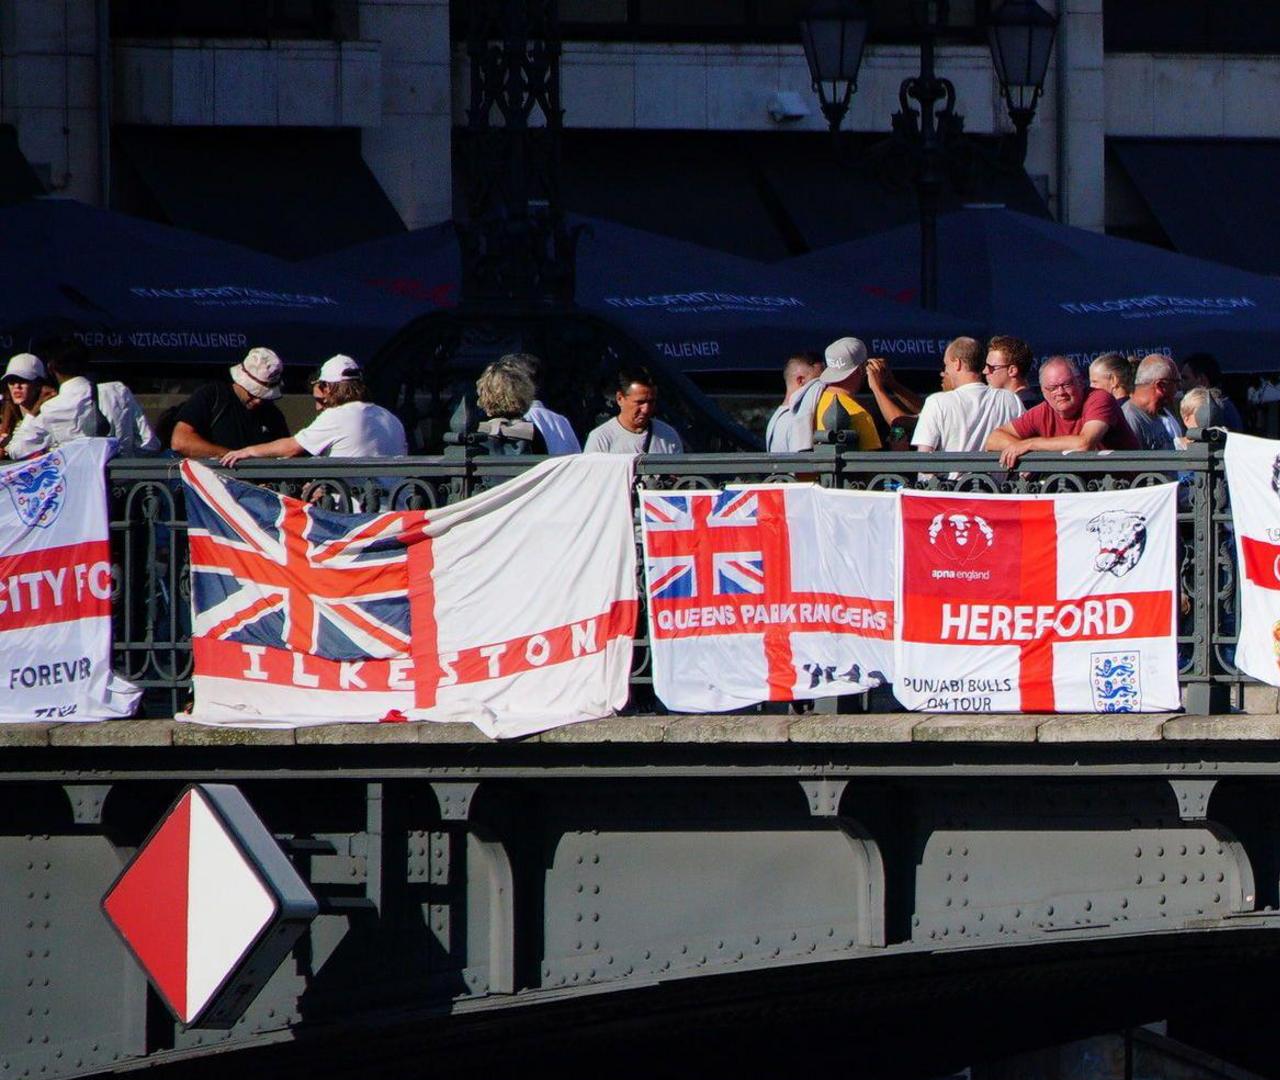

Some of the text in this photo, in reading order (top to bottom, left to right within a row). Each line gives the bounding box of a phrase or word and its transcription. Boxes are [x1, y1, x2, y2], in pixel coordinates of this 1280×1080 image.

[871, 338, 935, 354] FAVORITE
[74, 561, 112, 602] FC
[931, 569, 990, 581] apna england
[657, 605, 737, 630] QUEENS
[940, 598, 1135, 641] HEREFORD
[242, 620, 598, 691] ILKESTON
[968, 678, 1012, 693] BULLS
[952, 697, 992, 711] TOUR
